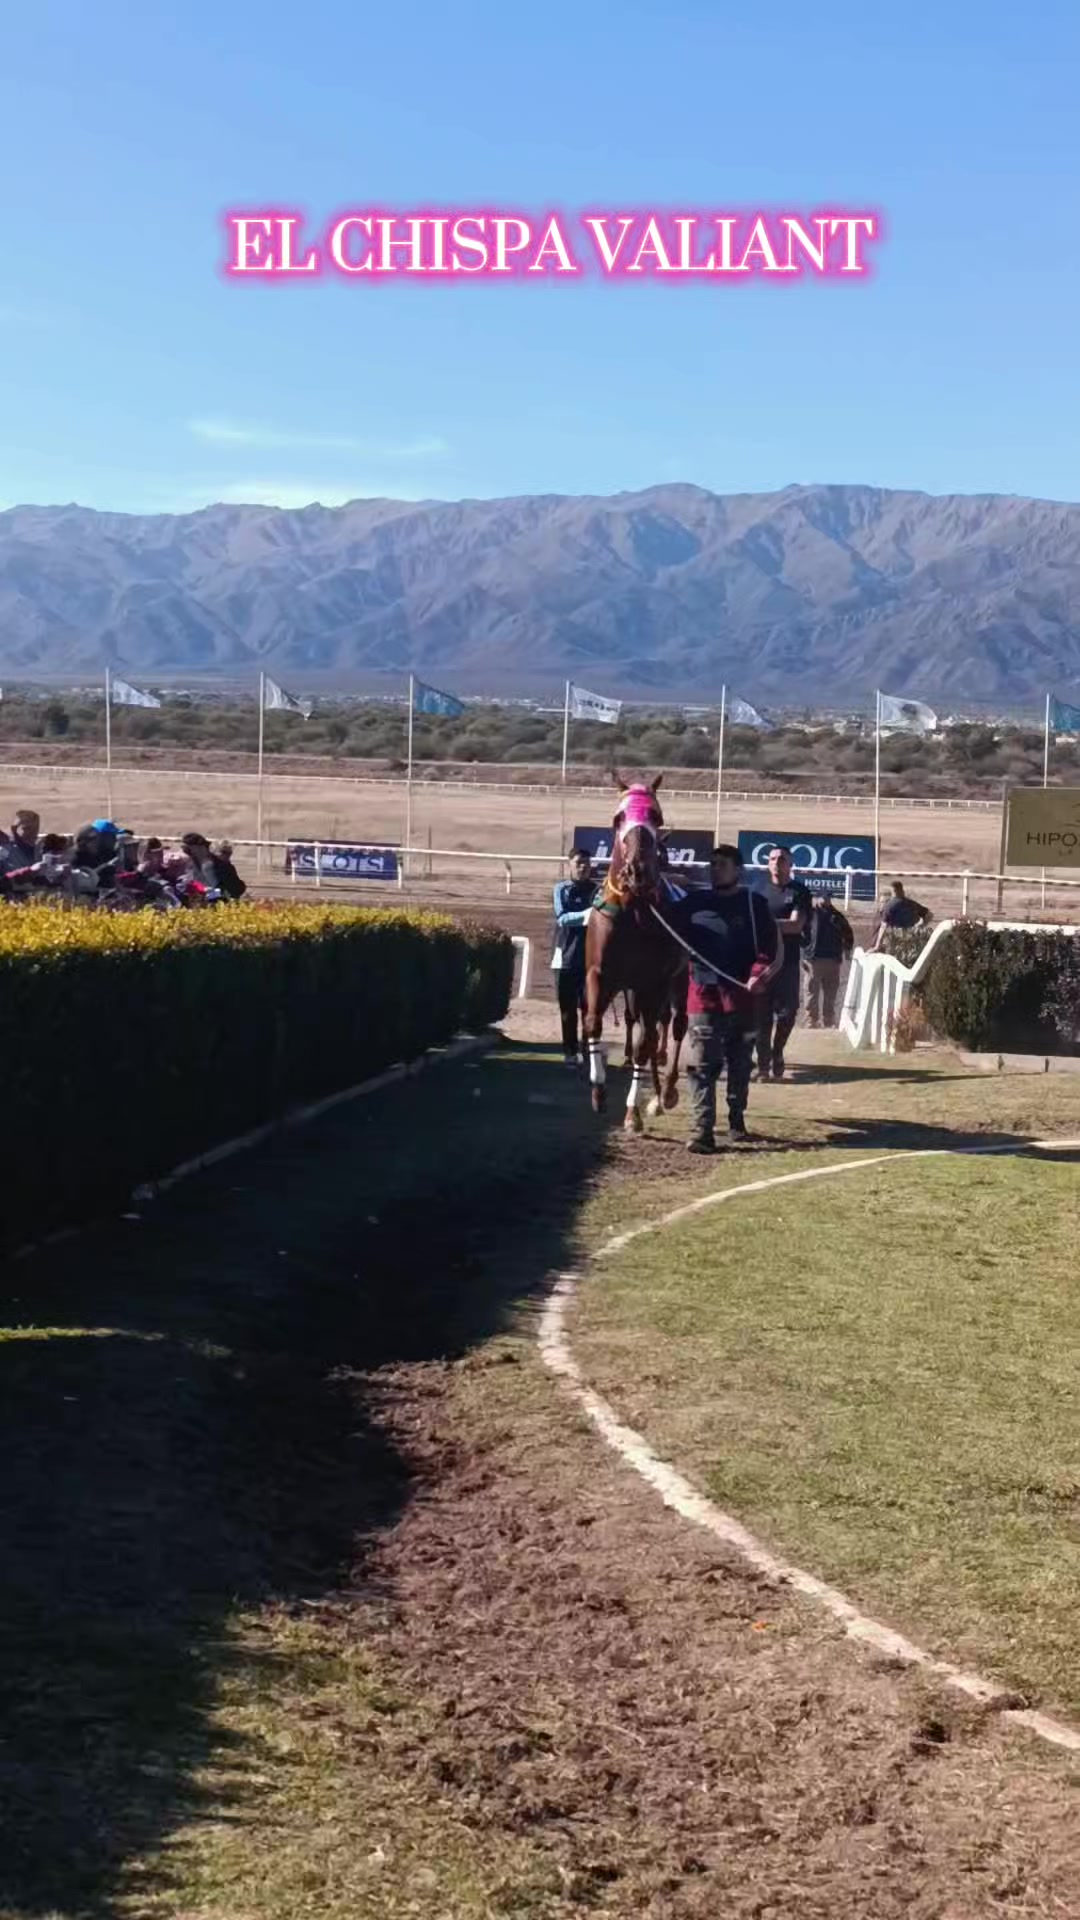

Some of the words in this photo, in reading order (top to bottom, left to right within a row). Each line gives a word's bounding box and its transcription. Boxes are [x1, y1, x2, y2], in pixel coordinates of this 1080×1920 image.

[1026, 832, 1080, 847] HIPO
[302, 853, 384, 871] SOTS
[804, 878, 849, 888] HOTELE
